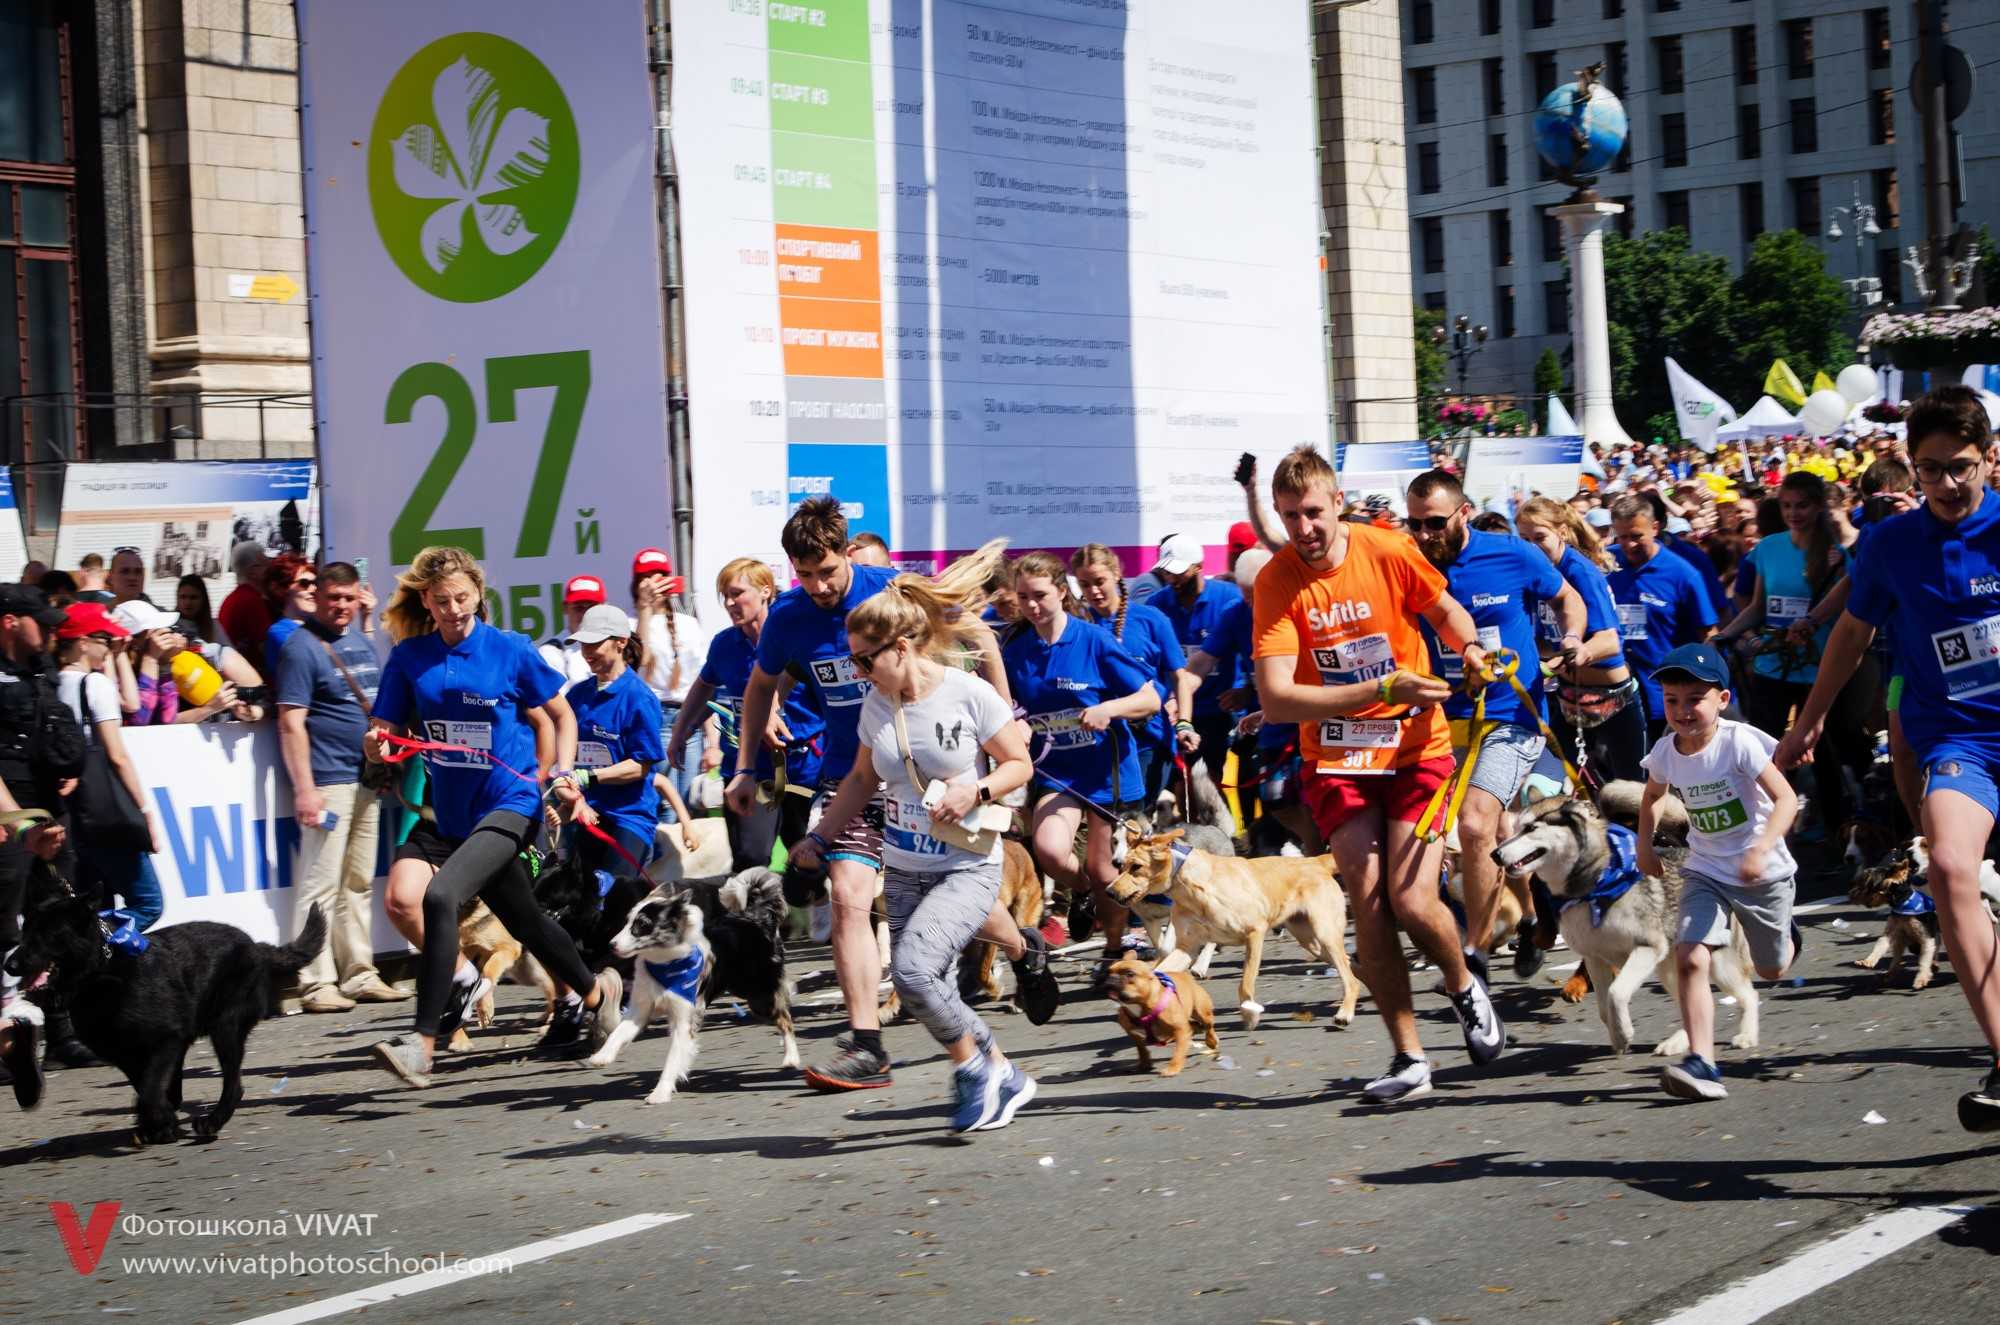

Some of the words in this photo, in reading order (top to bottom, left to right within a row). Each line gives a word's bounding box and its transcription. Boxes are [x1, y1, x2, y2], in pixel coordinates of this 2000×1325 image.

[768, 3, 808, 23] СТАРТ
[772, 83, 810, 103] СТАРТ
[775, 169, 813, 188] СТАРТ
[1308, 600, 1372, 631] Svitla
[1343, 750, 1373, 768] 301
